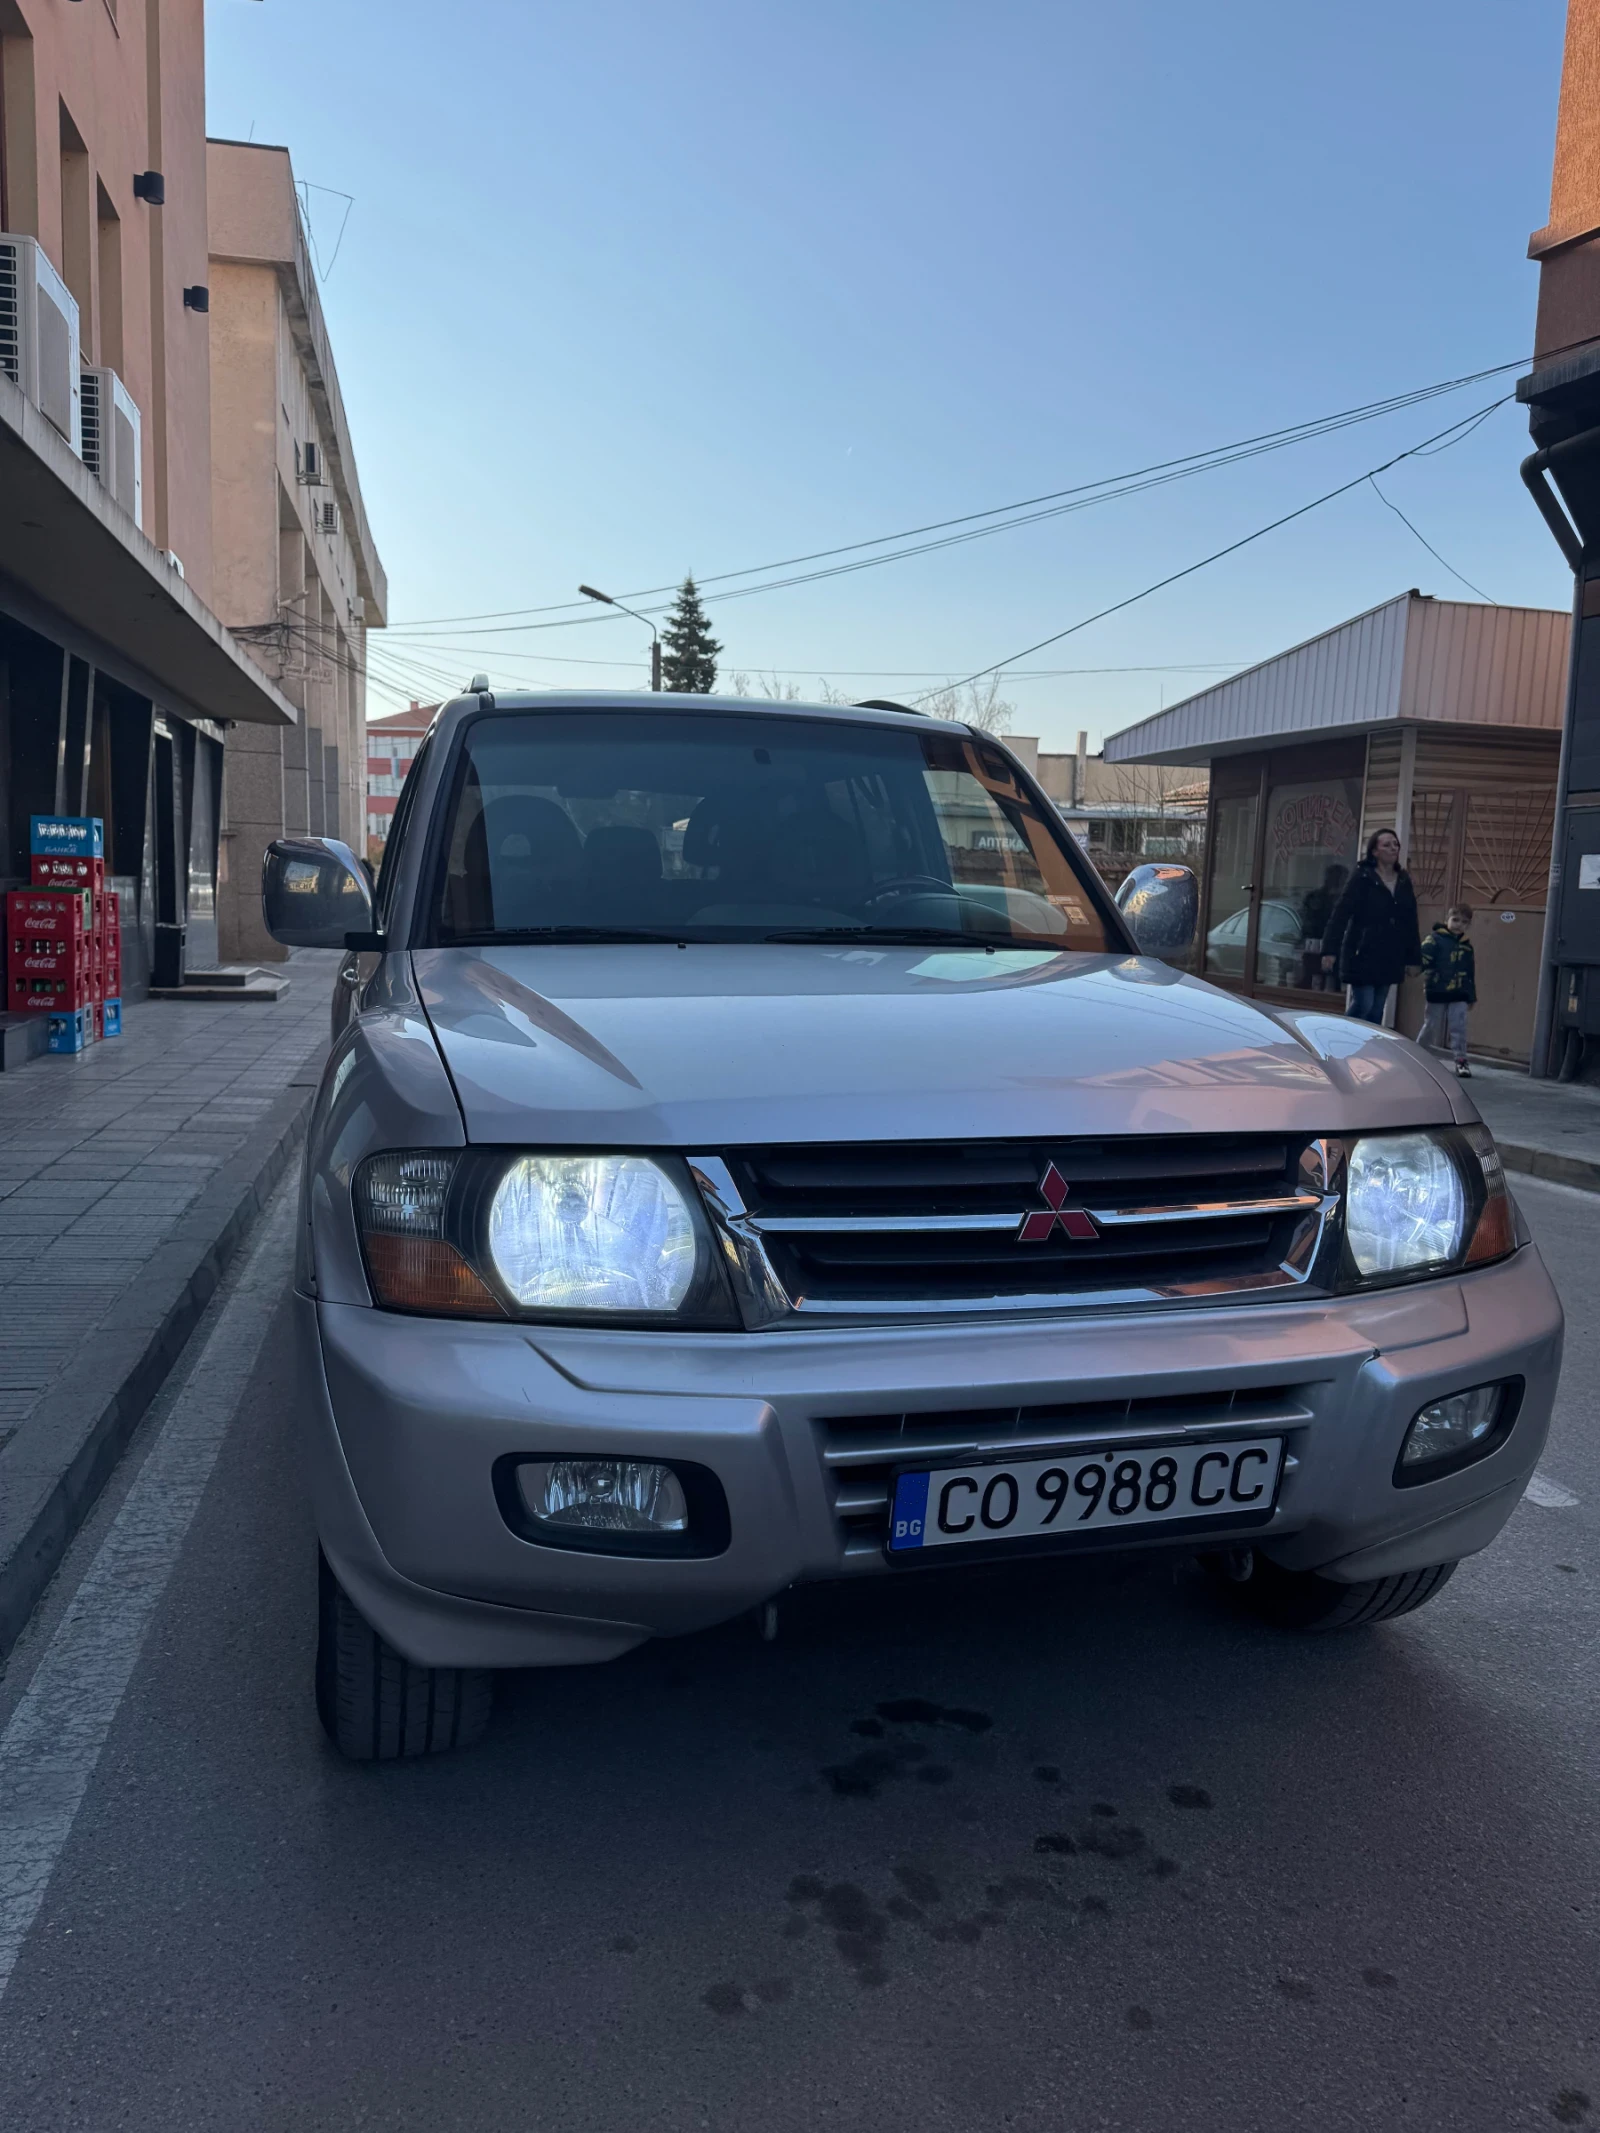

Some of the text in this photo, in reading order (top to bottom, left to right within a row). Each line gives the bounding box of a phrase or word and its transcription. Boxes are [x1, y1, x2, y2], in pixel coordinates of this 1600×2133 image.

[978, 835, 1024, 849] АПТЕКА
[1035, 1456, 1178, 1526] 9988
[1190, 1448, 1269, 1507] CC
[895, 1519, 922, 1538] BG
